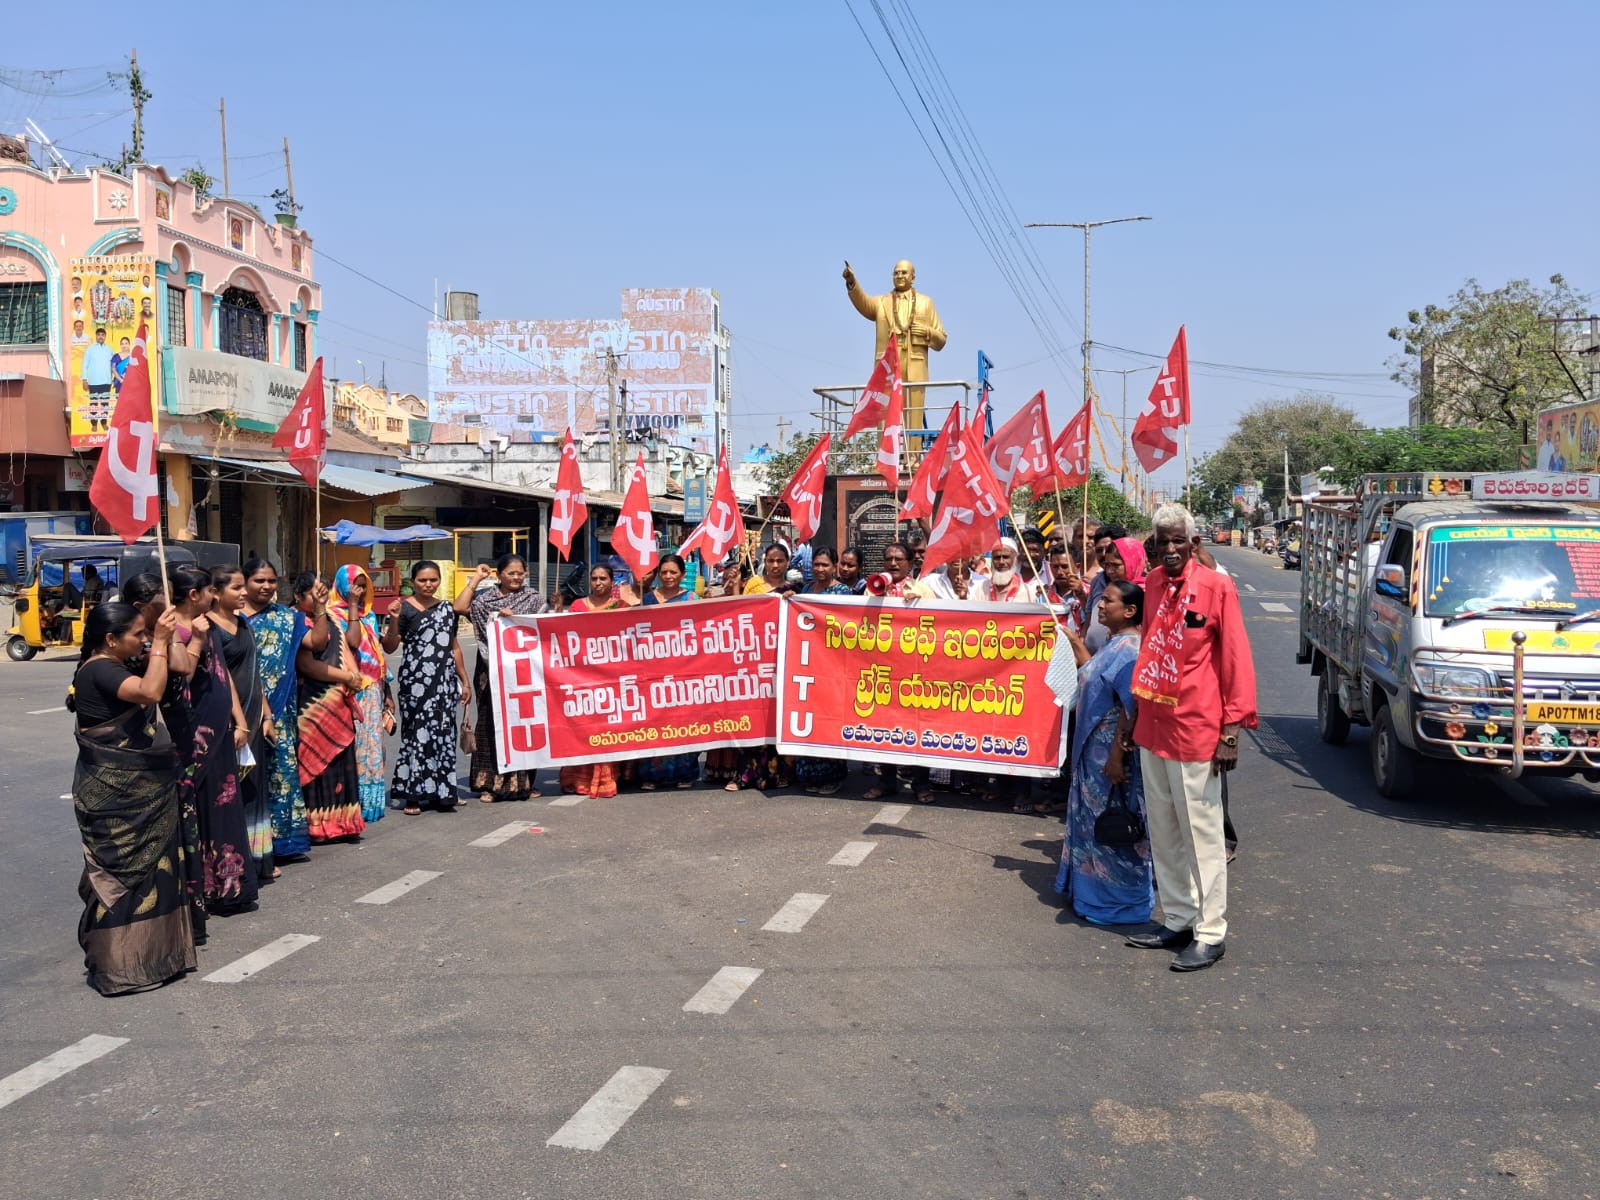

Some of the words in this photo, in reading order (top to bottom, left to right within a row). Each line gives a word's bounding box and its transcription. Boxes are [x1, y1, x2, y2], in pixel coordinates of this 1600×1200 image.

[636, 298, 685, 311] AUSTIN
[588, 331, 686, 354] AUSTIN
[188, 367, 238, 388] AMARON
[701, 613, 761, 664] వర్కర్స్
[764, 621, 778, 650] &
[825, 613, 893, 653] సెంటర్
[943, 620, 1056, 662] ఇండియన్
[502, 625, 546, 752] CITU
[560, 675, 646, 724] హెల్పర్స్
[650, 663, 777, 709] యూనియన్
[789, 613, 816, 738] CITU
[854, 664, 893, 718] ట్రేడ్
[898, 673, 1026, 717] యూనియన్
[1138, 673, 1159, 689] CITU
[588, 727, 658, 747] అమరావతి
[661, 721, 711, 740] మండల
[842, 724, 918, 746] అమరావతి
[920, 730, 978, 751] మండల
